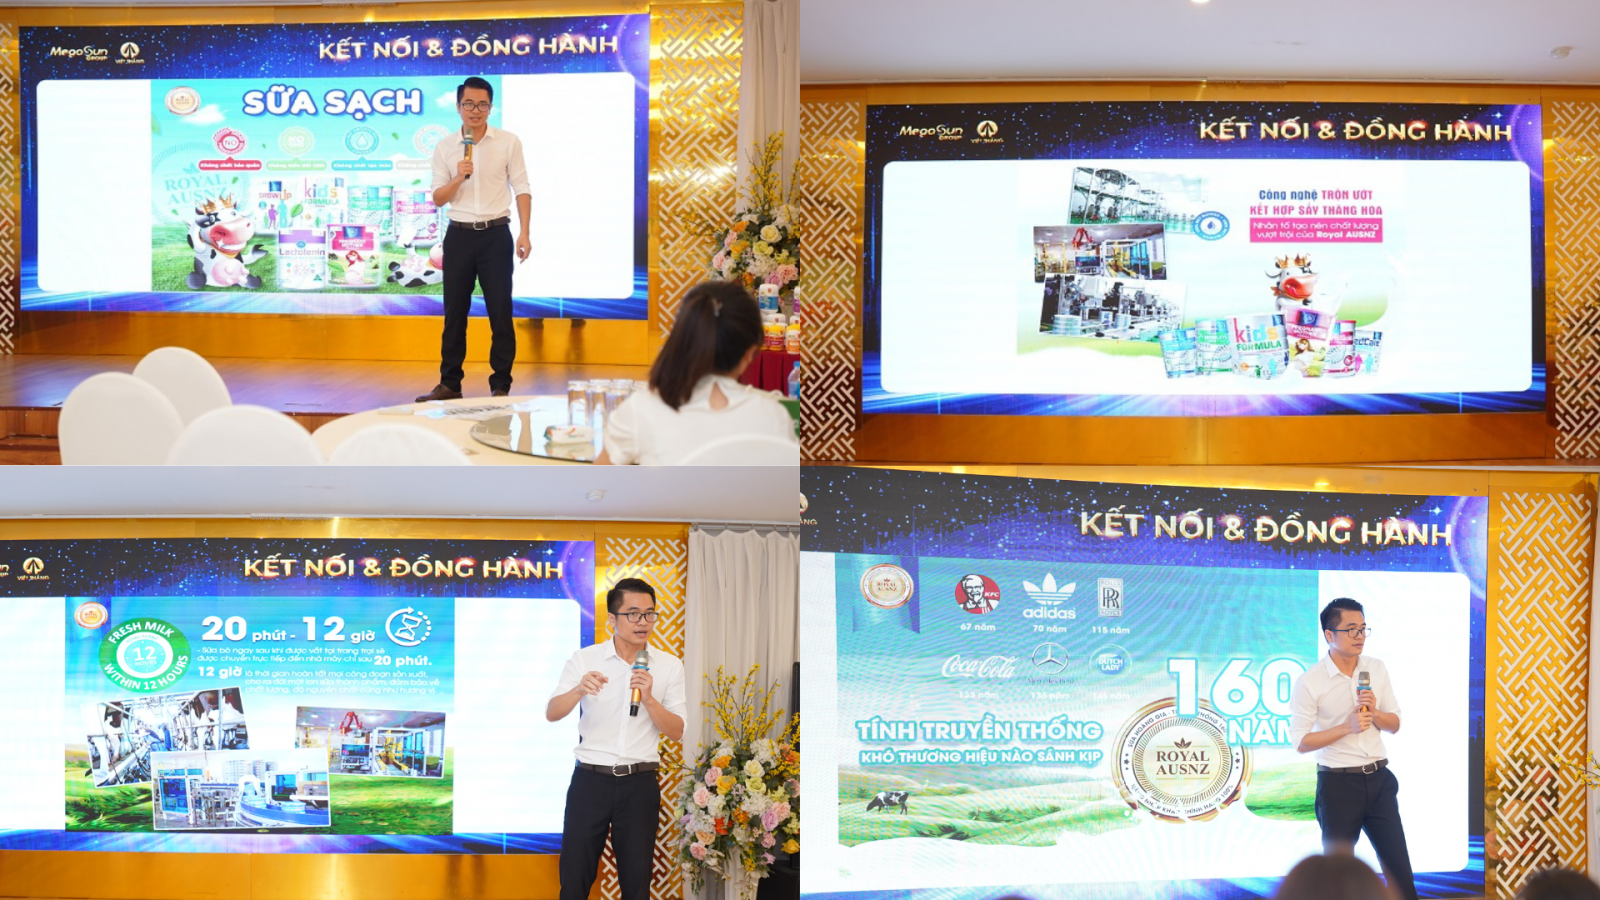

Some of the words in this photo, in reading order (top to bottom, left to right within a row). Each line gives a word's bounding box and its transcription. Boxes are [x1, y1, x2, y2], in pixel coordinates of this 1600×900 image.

[319, 36, 366, 60] KẾT
[373, 35, 419, 59] NỐI
[427, 39, 444, 57] &
[450, 34, 531, 58] ĐỒNG
[538, 32, 618, 55] HÀNH
[243, 84, 317, 116] SỮA
[324, 88, 423, 121] SẠCH
[1200, 116, 1253, 140] KẾT
[1260, 116, 1309, 140] NỐI
[1317, 122, 1336, 140] &
[1343, 117, 1426, 141] ĐỒNG
[1434, 119, 1512, 142] HÀNH
[165, 174, 227, 191] ROYAL
[304, 177, 338, 198] kids
[1259, 189, 1287, 201] Công
[1290, 189, 1318, 202] nghệ
[1321, 188, 1349, 201] TRỘN
[1352, 188, 1373, 200] ƯỚT
[1250, 202, 1269, 215] KẾT
[1273, 205, 1295, 217] HỢP
[1298, 202, 1319, 215] SẤY
[1323, 203, 1357, 215] THĂNG
[1361, 205, 1383, 215] HOA
[1253, 221, 1279, 230] Nhân
[1280, 221, 1290, 230] tố
[1292, 222, 1308, 231] tạo
[1310, 221, 1328, 230] nên
[1330, 221, 1351, 230] chất
[1353, 221, 1379, 231] lượng
[1256, 231, 1277, 239] vượt
[1279, 231, 1294, 239] trội
[1316, 231, 1343, 240] Royal
[279, 248, 326, 256] Lactoferrin
[1233, 318, 1279, 343] kids
[1236, 340, 1282, 351] FORMULA
[1080, 505, 1145, 539] KẾT
[1154, 508, 1213, 541] NỐI
[1223, 517, 1245, 541] &
[1254, 512, 1351, 544] ĐỒNG
[1361, 516, 1453, 547] HÀNH
[244, 552, 297, 577] KẾT
[305, 552, 354, 577] NỐI
[363, 560, 382, 577] &
[389, 554, 474, 578] ĐỒNG
[483, 556, 563, 579] HÀNH
[1022, 606, 1076, 620] adidas
[108, 621, 142, 644] FRESH
[144, 621, 175, 638] MILK
[201, 615, 247, 641] 20
[252, 629, 287, 643] phút
[302, 616, 345, 641] 12
[350, 630, 376, 644] giờ
[960, 623, 972, 631] 67
[974, 623, 996, 631] năm
[1046, 625, 1067, 633] năm
[1092, 626, 1108, 634] 115
[1110, 626, 1130, 634] năm
[132, 645, 157, 661] 12
[285, 647, 307, 655] được
[324, 647, 335, 655] tại
[361, 647, 374, 655] trại
[220, 654, 251, 662] chuyển
[252, 655, 268, 663] trực
[288, 654, 304, 662] đến
[324, 655, 342, 663] máy
[374, 655, 391, 666] 20
[395, 655, 433, 668] phút.
[104, 663, 141, 690] WITHIN
[143, 680, 157, 690] 12
[157, 655, 189, 687] HOURS
[198, 666, 215, 677] 12
[219, 666, 242, 680] giờ
[345, 671, 367, 679] công
[1168, 657, 1305, 717] 160
[1154, 712, 1168, 720] GIA
[857, 716, 916, 740] TÍNH
[922, 713, 1012, 740] TRUYỀN
[1017, 714, 1102, 740] THỐNG
[861, 748, 895, 763] KHÓ
[899, 750, 962, 763] THƯƠNG
[965, 749, 997, 765] HIỆU
[1001, 748, 1033, 763] NÀO
[1037, 748, 1075, 762] SÁNH
[1079, 751, 1102, 765] KỊP
[1156, 750, 1210, 762] ROYAL
[1156, 763, 1210, 775] AUSNZ
